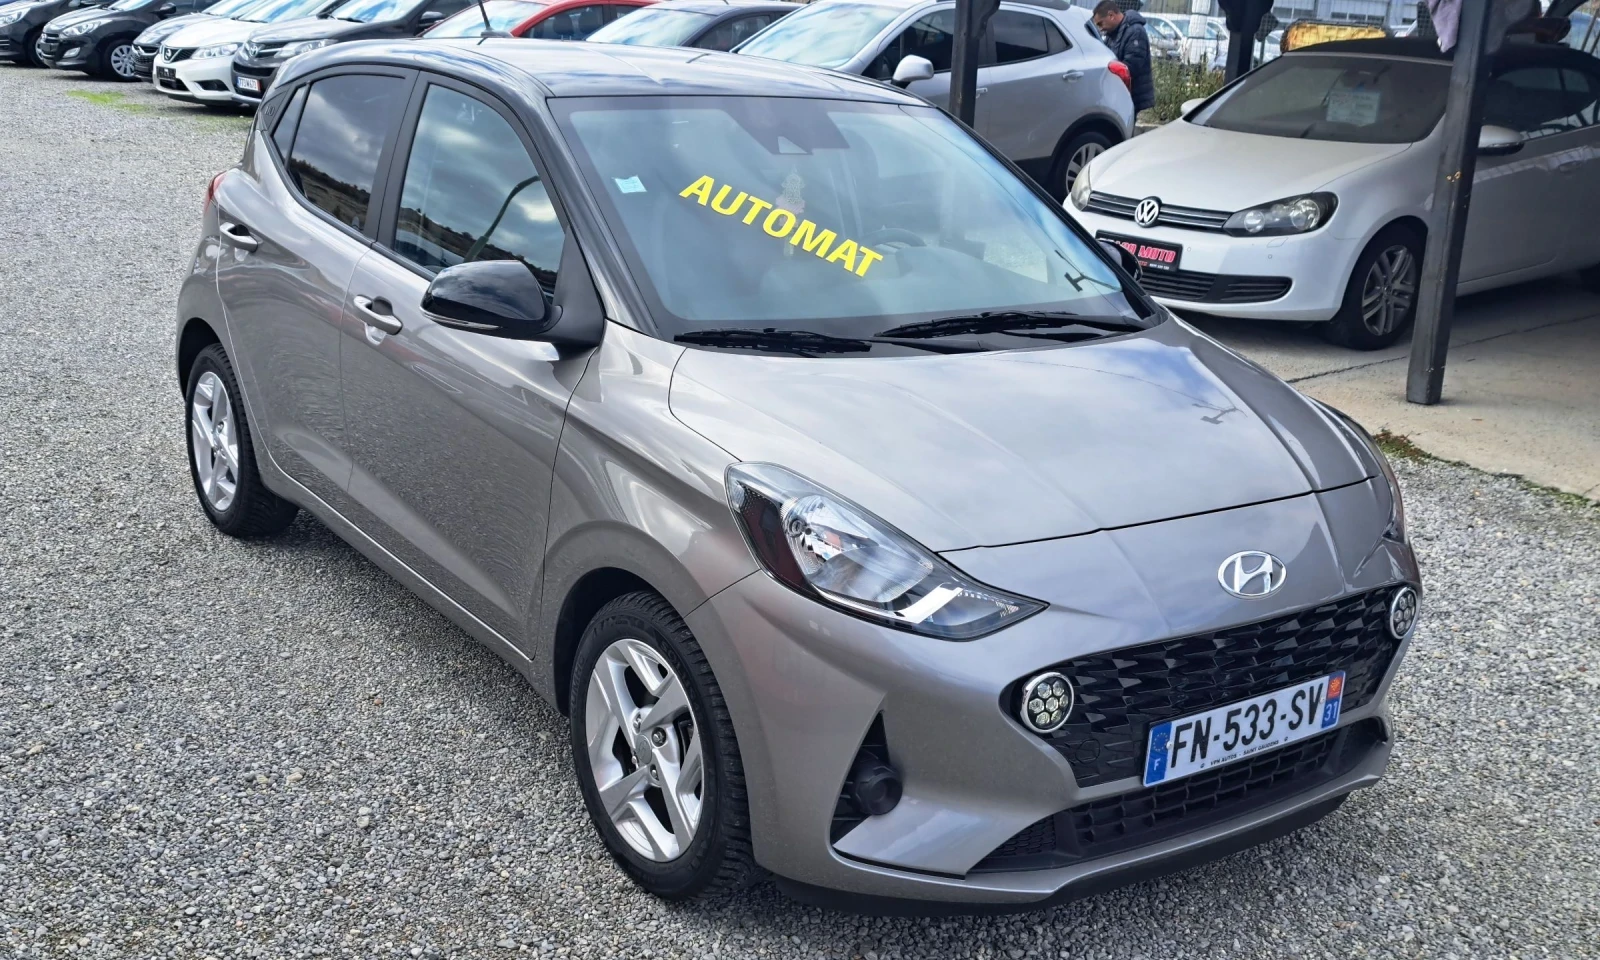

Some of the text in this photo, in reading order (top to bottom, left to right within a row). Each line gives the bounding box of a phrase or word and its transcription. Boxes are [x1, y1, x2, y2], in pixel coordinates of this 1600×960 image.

[678, 175, 883, 278] AUTOMAT
[1138, 245, 1176, 263] MOTO
[1324, 702, 1338, 722] 31
[1170, 683, 1324, 768] FN-533-SV
[1221, 754, 1237, 762] AUTOS
[1258, 740, 1279, 750] GAUDENS
[1153, 758, 1162, 770] F
